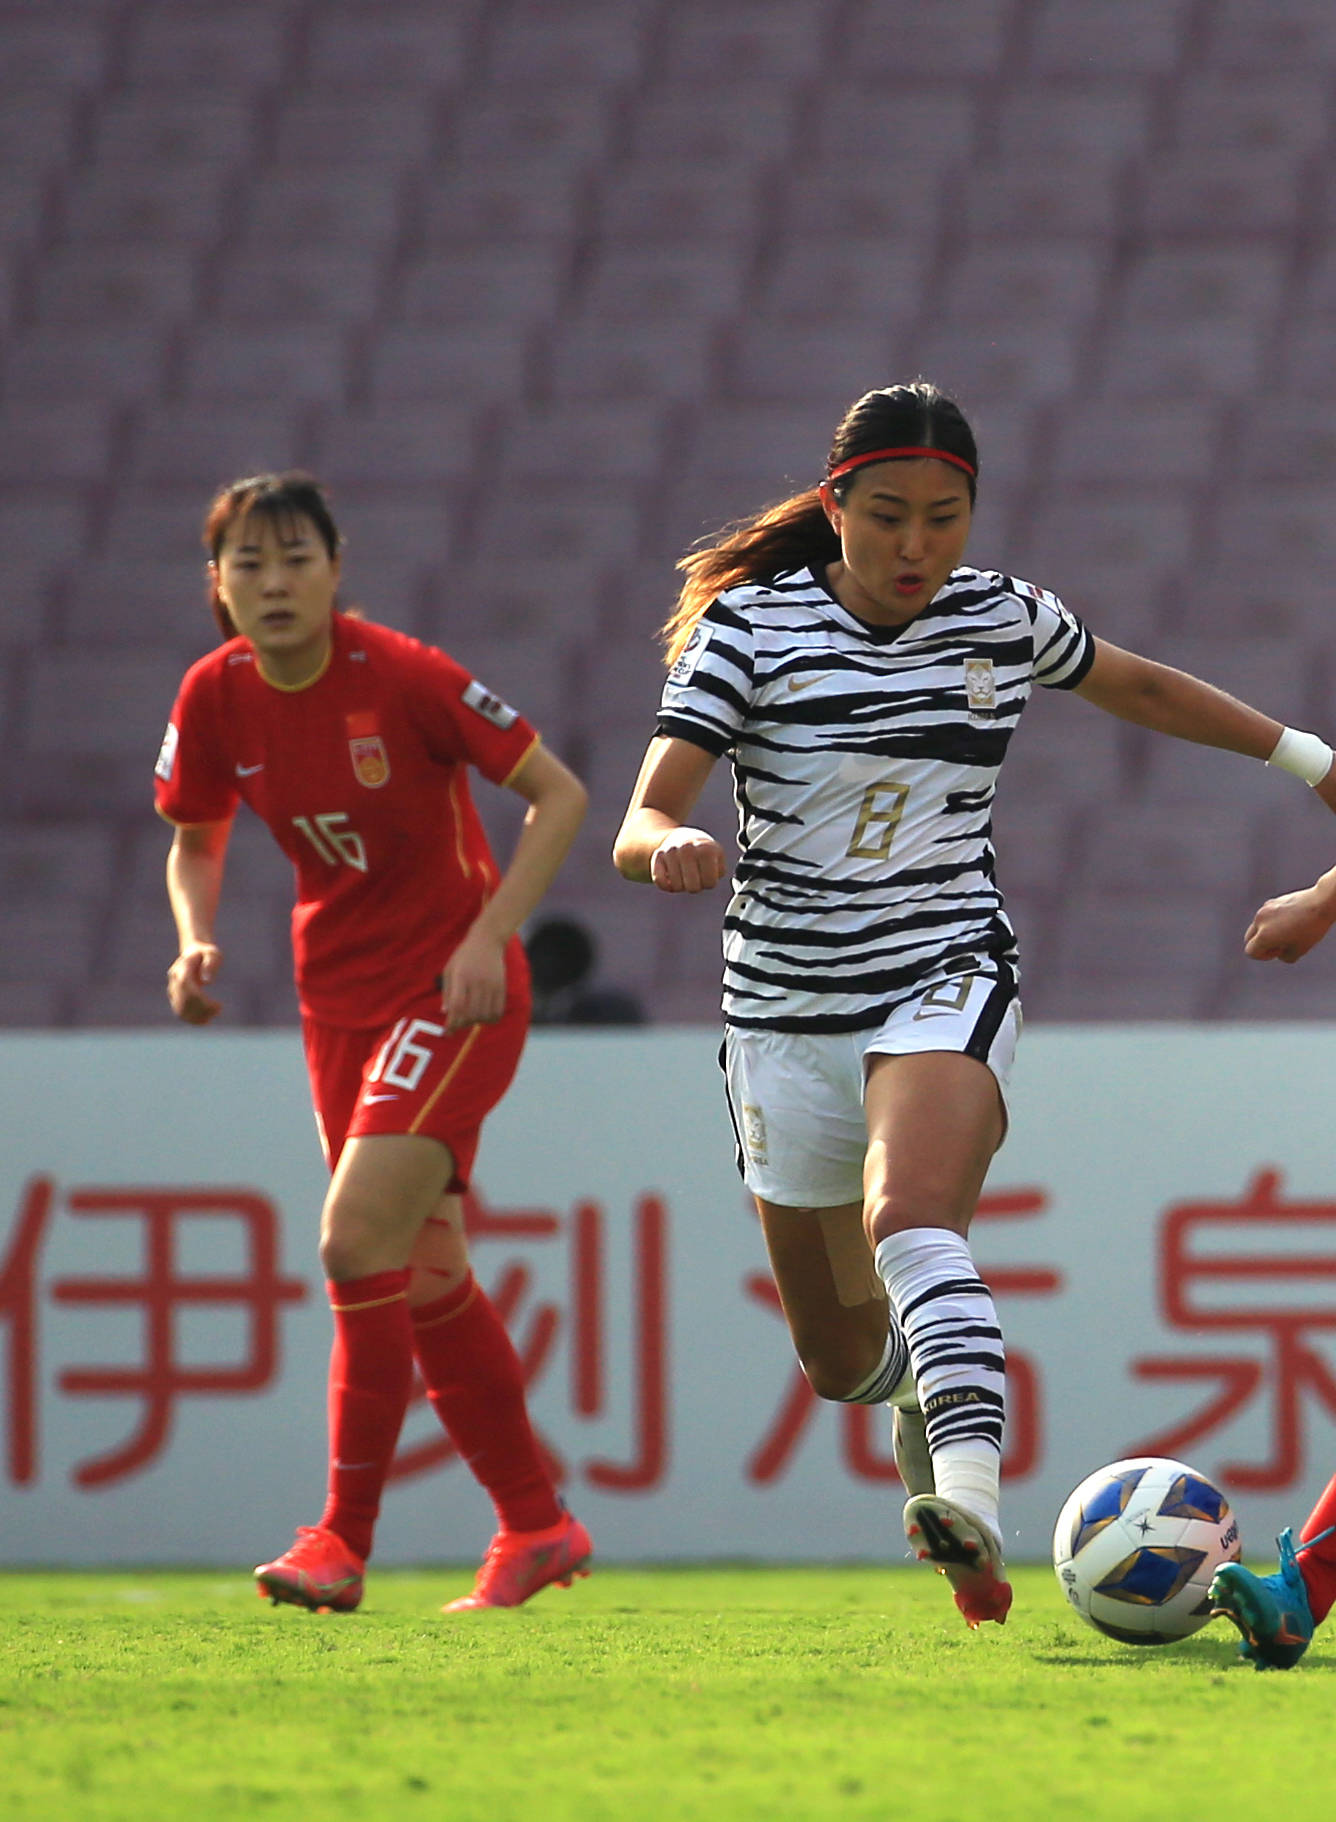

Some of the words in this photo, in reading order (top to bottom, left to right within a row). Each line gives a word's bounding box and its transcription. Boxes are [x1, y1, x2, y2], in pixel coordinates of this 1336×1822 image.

[292, 812, 368, 873] 16
[846, 781, 910, 860] 8
[367, 1016, 445, 1091] 16
